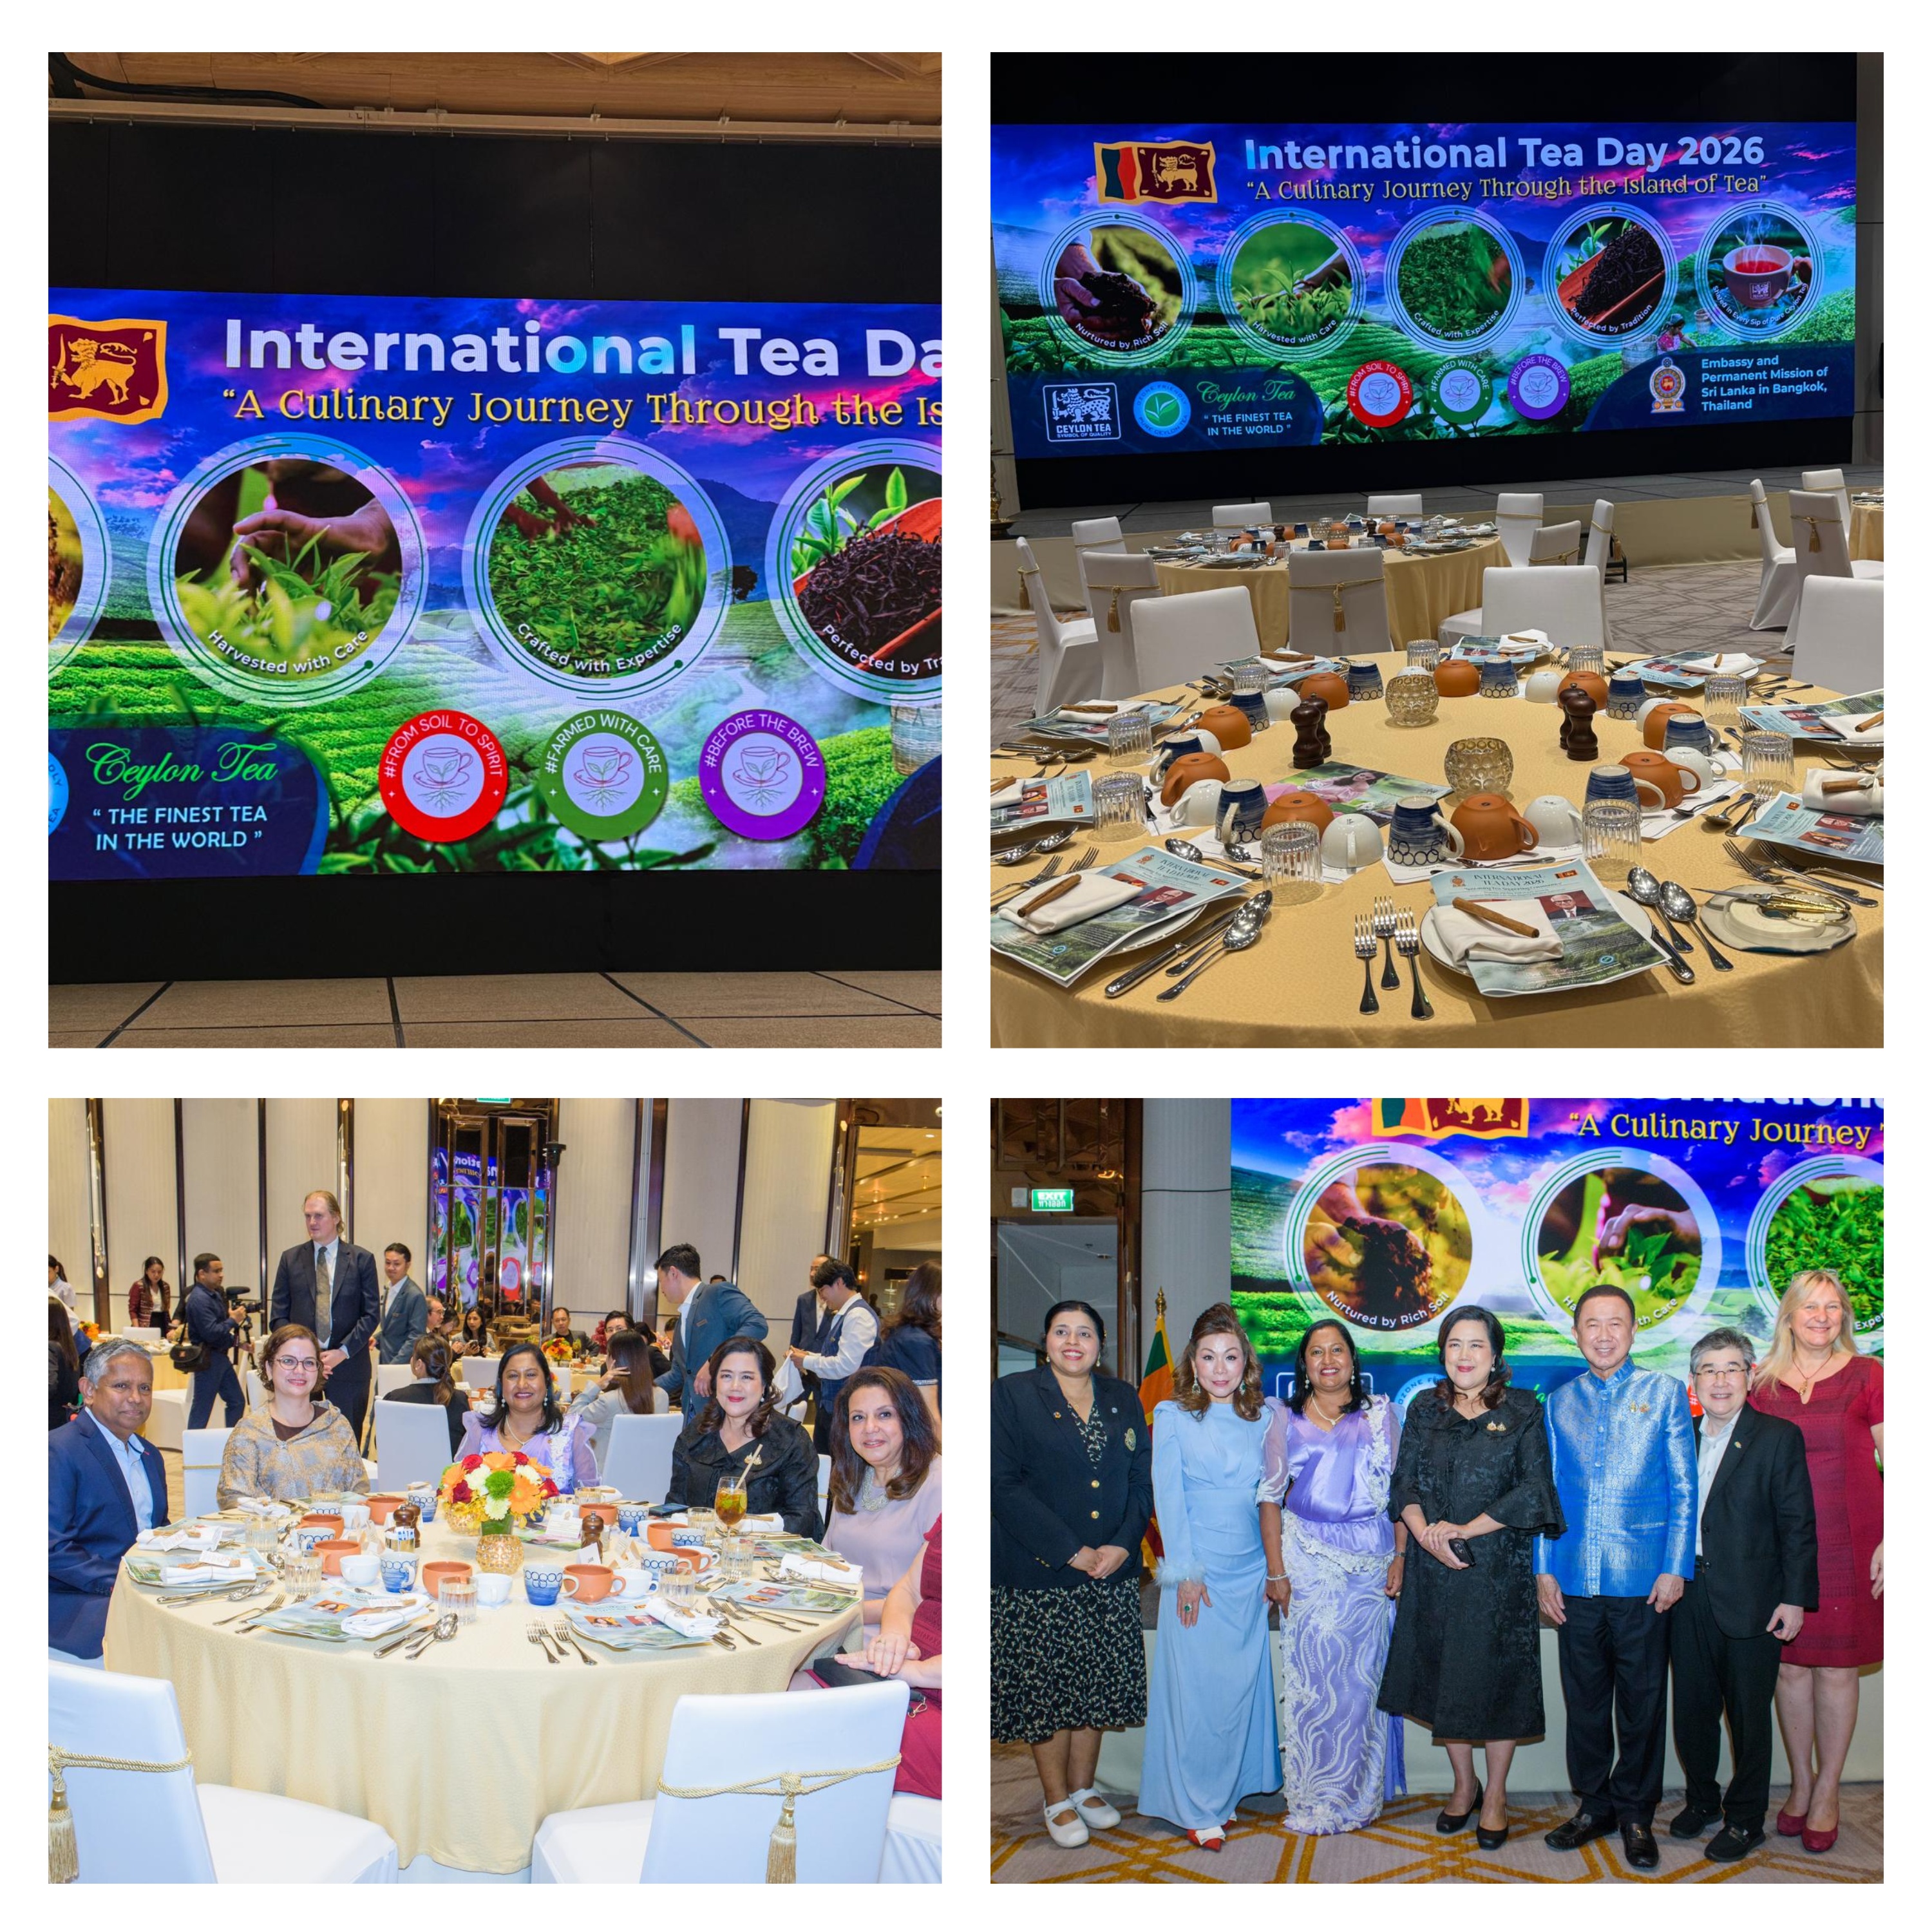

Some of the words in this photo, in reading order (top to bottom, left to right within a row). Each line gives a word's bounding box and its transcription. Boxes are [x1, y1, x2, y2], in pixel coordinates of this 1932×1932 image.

[1245, 136, 1506, 169] International
[1518, 137, 1583, 167] Tea
[1597, 137, 1668, 172] Day
[1678, 136, 1765, 165] 2026
[1278, 179, 1374, 202] Culinary
[1383, 180, 1472, 201] Journey
[1479, 177, 1571, 200] Through
[1578, 175, 1616, 194] the
[1624, 175, 1687, 194] Island
[1694, 173, 1718, 193] of
[1252, 320, 1296, 343] Harvested
[1298, 333, 1318, 343] with
[1319, 319, 1336, 336] Care
[1414, 312, 1442, 336] Crafted
[1465, 309, 1500, 337] Expertise
[1571, 307, 1607, 332] Perfected
[1609, 325, 1619, 333] by
[1620, 304, 1653, 330] Tradition
[1750, 318, 1761, 327] Sip
[226, 319, 696, 375] International
[718, 328, 839, 376] Tea
[1075, 323, 1116, 348] Nurtured
[1119, 341, 1130, 349] by
[1133, 334, 1153, 346] Rich
[1153, 321, 1169, 337] Soil
[1430, 360, 1456, 392] #FARMED
[1457, 359, 1477, 369] WITH
[1475, 367, 1490, 390] CARE
[1510, 356, 1537, 386] #BEFORE
[1538, 356, 1553, 366] THE
[1551, 361, 1567, 383] BREW
[1701, 357, 1754, 370] Embassy
[1756, 355, 1779, 366] and
[1701, 370, 1767, 383] Permanent
[1770, 368, 1814, 381] Mission
[1816, 366, 1828, 377] of
[1349, 368, 1366, 397] #FROM
[1366, 362, 1383, 372] SOIL
[1386, 364, 1397, 374] TO
[1395, 372, 1410, 395] SPIRIT
[1701, 387, 1717, 397] Sri
[1720, 385, 1755, 397] Lanka
[1759, 384, 1769, 394] in
[1772, 381, 1827, 396] Bangkok,
[279, 388, 453, 426] Culinary
[468, 392, 632, 428] Journey
[647, 392, 819, 430] Through
[832, 392, 902, 425] the
[1197, 381, 1258, 412] Ceylon
[1262, 379, 1296, 401] Tea
[1701, 399, 1752, 412] Thailand
[1056, 424, 1094, 433] CEYLON
[1094, 423, 1111, 432] TEA
[1208, 426, 1218, 436] IN
[1222, 426, 1243, 435] THE
[1245, 424, 1284, 434] WORLD
[1212, 414, 1233, 423] THE
[1235, 412, 1270, 422] FINEST
[1273, 412, 1293, 421] TEA
[207, 629, 288, 674] Harvested
[293, 654, 330, 674] with
[334, 630, 368, 662] Care
[517, 623, 571, 667] Crafted
[575, 658, 611, 673] with
[616, 623, 683, 669] Expertise
[822, 624, 895, 671] Perfected
[901, 661, 920, 676] by
[384, 724, 419, 778] #FROM
[419, 714, 453, 731] SOIL
[459, 717, 478, 736] TO
[477, 734, 502, 777] SPIRIT
[544, 714, 596, 775] #FARMED
[600, 713, 639, 735] WITH
[636, 732, 662, 774] CARE
[704, 713, 756, 768] #BEFORE
[759, 713, 790, 734] THE
[786, 725, 820, 768] BREW
[85, 742, 203, 801] Ceylon
[211, 741, 279, 782] Tea
[108, 808, 148, 824] THE
[155, 806, 226, 824] FINEST
[230, 805, 268, 822] TEA
[96, 833, 122, 851] IN
[127, 832, 165, 849] THE
[171, 830, 247, 849] WORLD
[1611, 1112, 1740, 1144] Culinary
[1750, 1119, 1871, 1150] Journey
[1037, 1191, 1066, 1201] EXIT
[1325, 1290, 1377, 1325] Nurtured
[1381, 1316, 1396, 1328] by
[1401, 1309, 1428, 1325] Rich
[1428, 1292, 1450, 1314] Soil
[1653, 1297, 1678, 1319] Care
